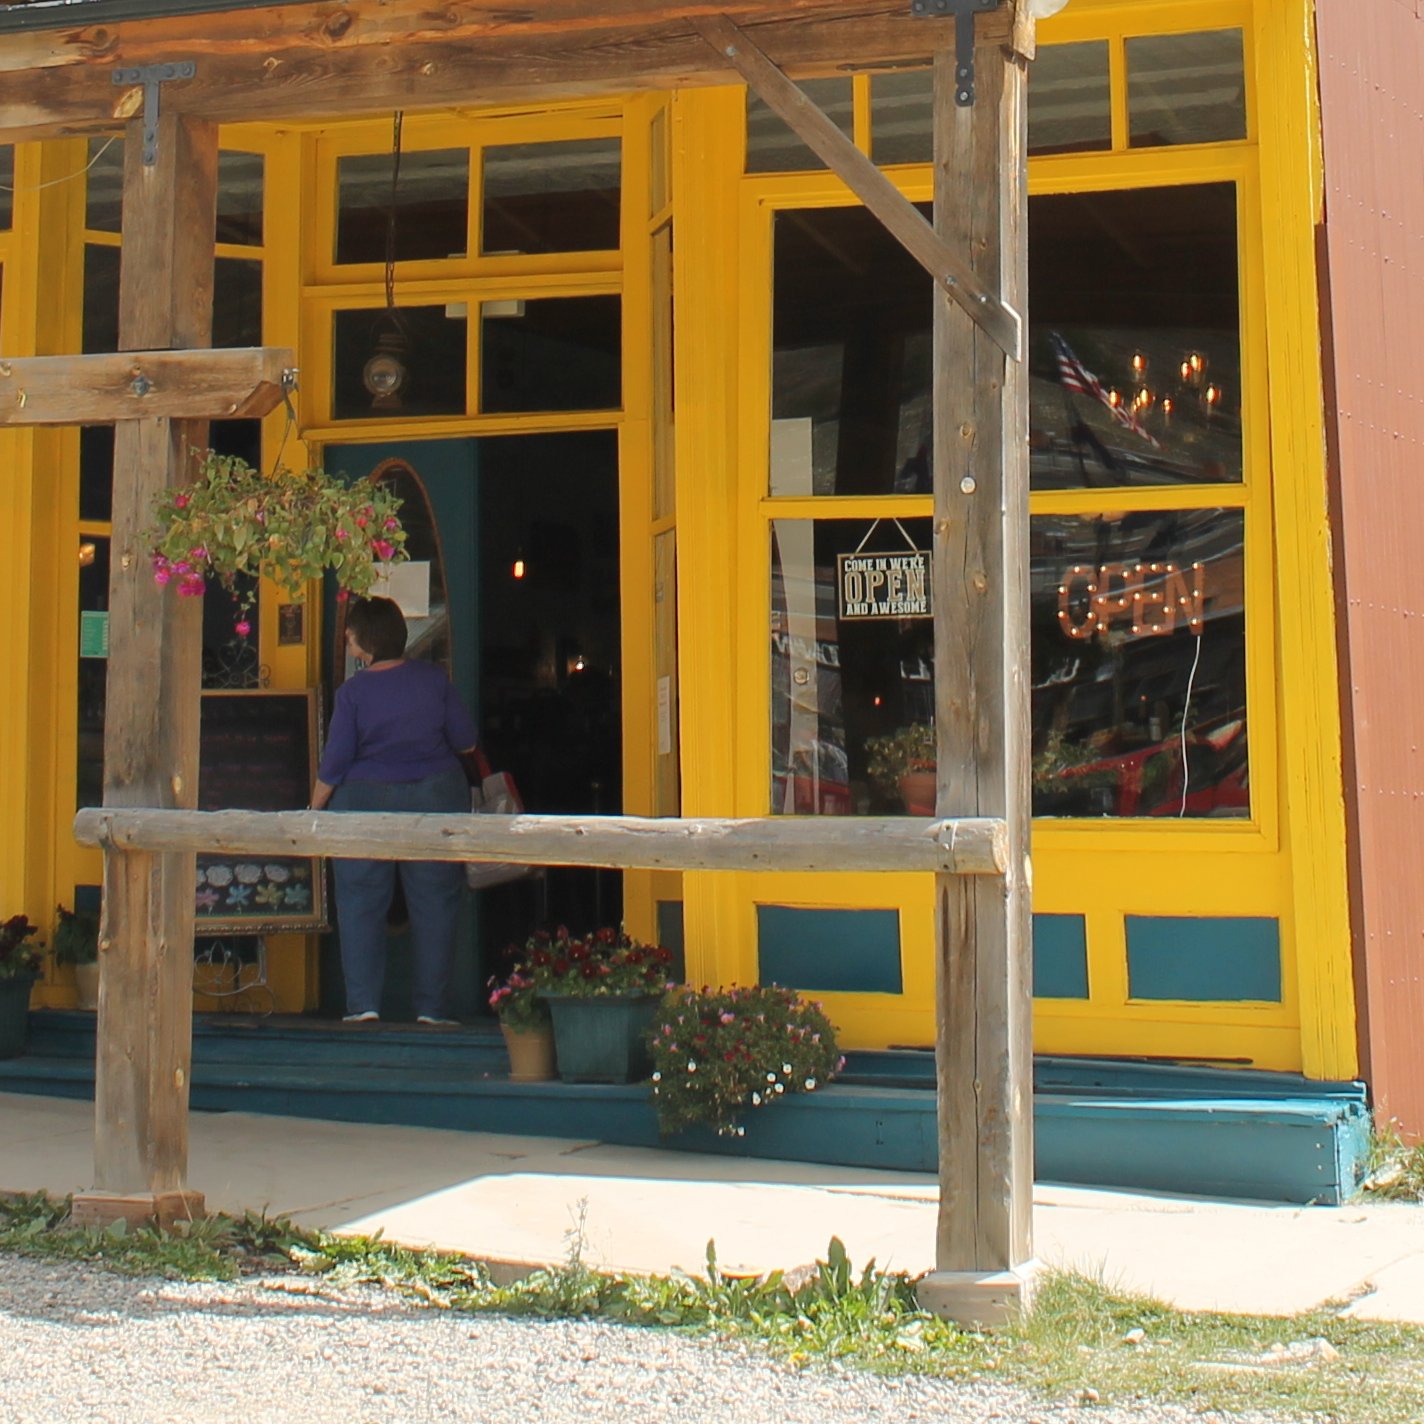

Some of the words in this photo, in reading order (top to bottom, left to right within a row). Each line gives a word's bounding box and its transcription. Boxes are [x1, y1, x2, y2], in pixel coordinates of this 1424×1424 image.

[844, 558, 874, 572] COME
[876, 557, 887, 570] IN
[844, 568, 927, 604] OPEN
[846, 602, 868, 616] AND
[870, 600, 927, 615] AWESOME
[1057, 562, 1206, 640] OPEN
